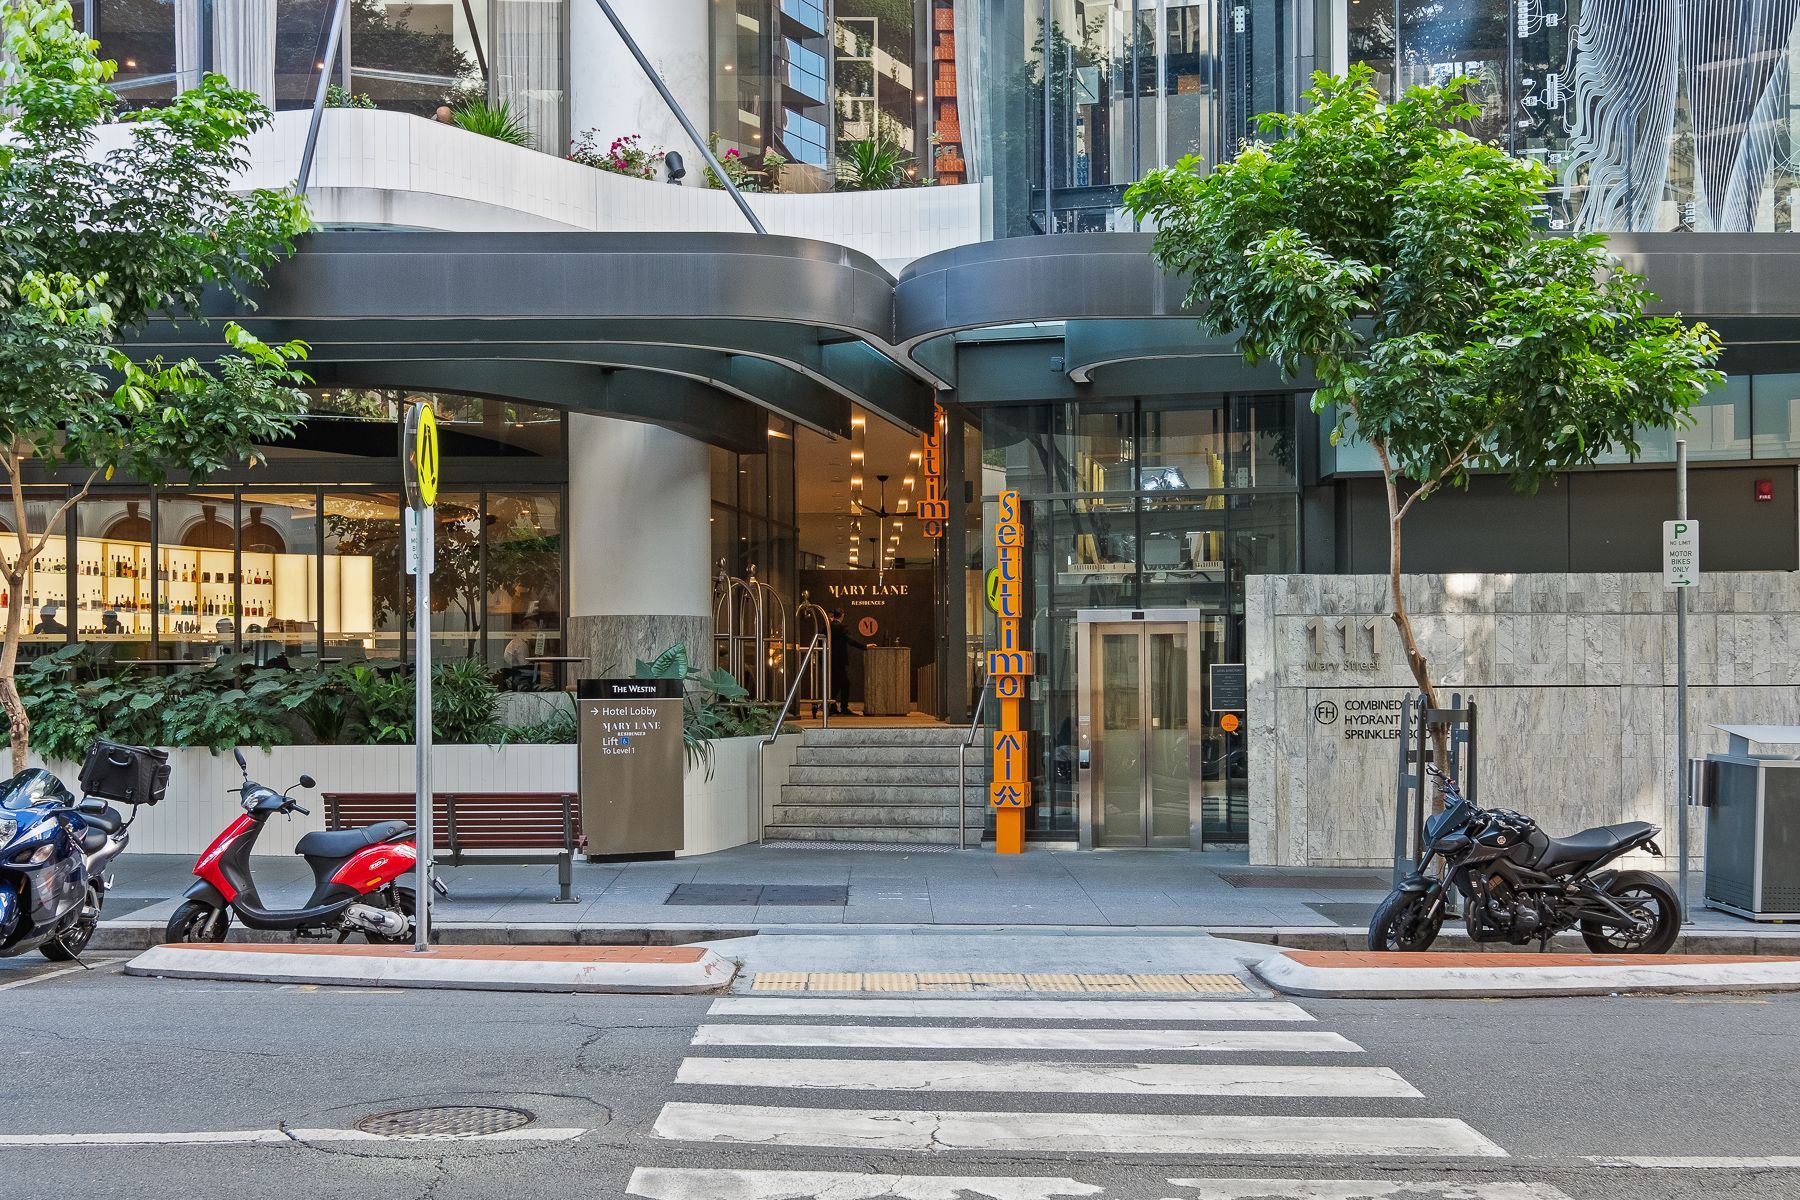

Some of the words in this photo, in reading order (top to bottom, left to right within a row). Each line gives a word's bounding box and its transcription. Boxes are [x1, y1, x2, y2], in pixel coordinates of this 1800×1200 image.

[1674, 523, 1688, 539] P
[828, 585, 868, 598] MARY
[872, 585, 909, 595] LANE
[990, 492, 1023, 696] Settimo
[1306, 615, 1383, 654] 111
[1306, 660, 1340, 673] Mary
[1343, 659, 1380, 671] Street
[612, 685, 628, 693] THE
[628, 684, 657, 693] WESTIN
[1344, 700, 1402, 711] COMBINED
[602, 706, 628, 716] Hotel
[630, 706, 657, 717] Lobby
[1318, 706, 1335, 719] FH
[1344, 714, 1401, 725] HYDRANT
[602, 721, 632, 732] MARY
[635, 721, 661, 730] LANE
[1344, 729, 1401, 740] SPRINKLER
[602, 736, 619, 746] Lift
[602, 747, 611, 755] To
[612, 746, 631, 755] Level
